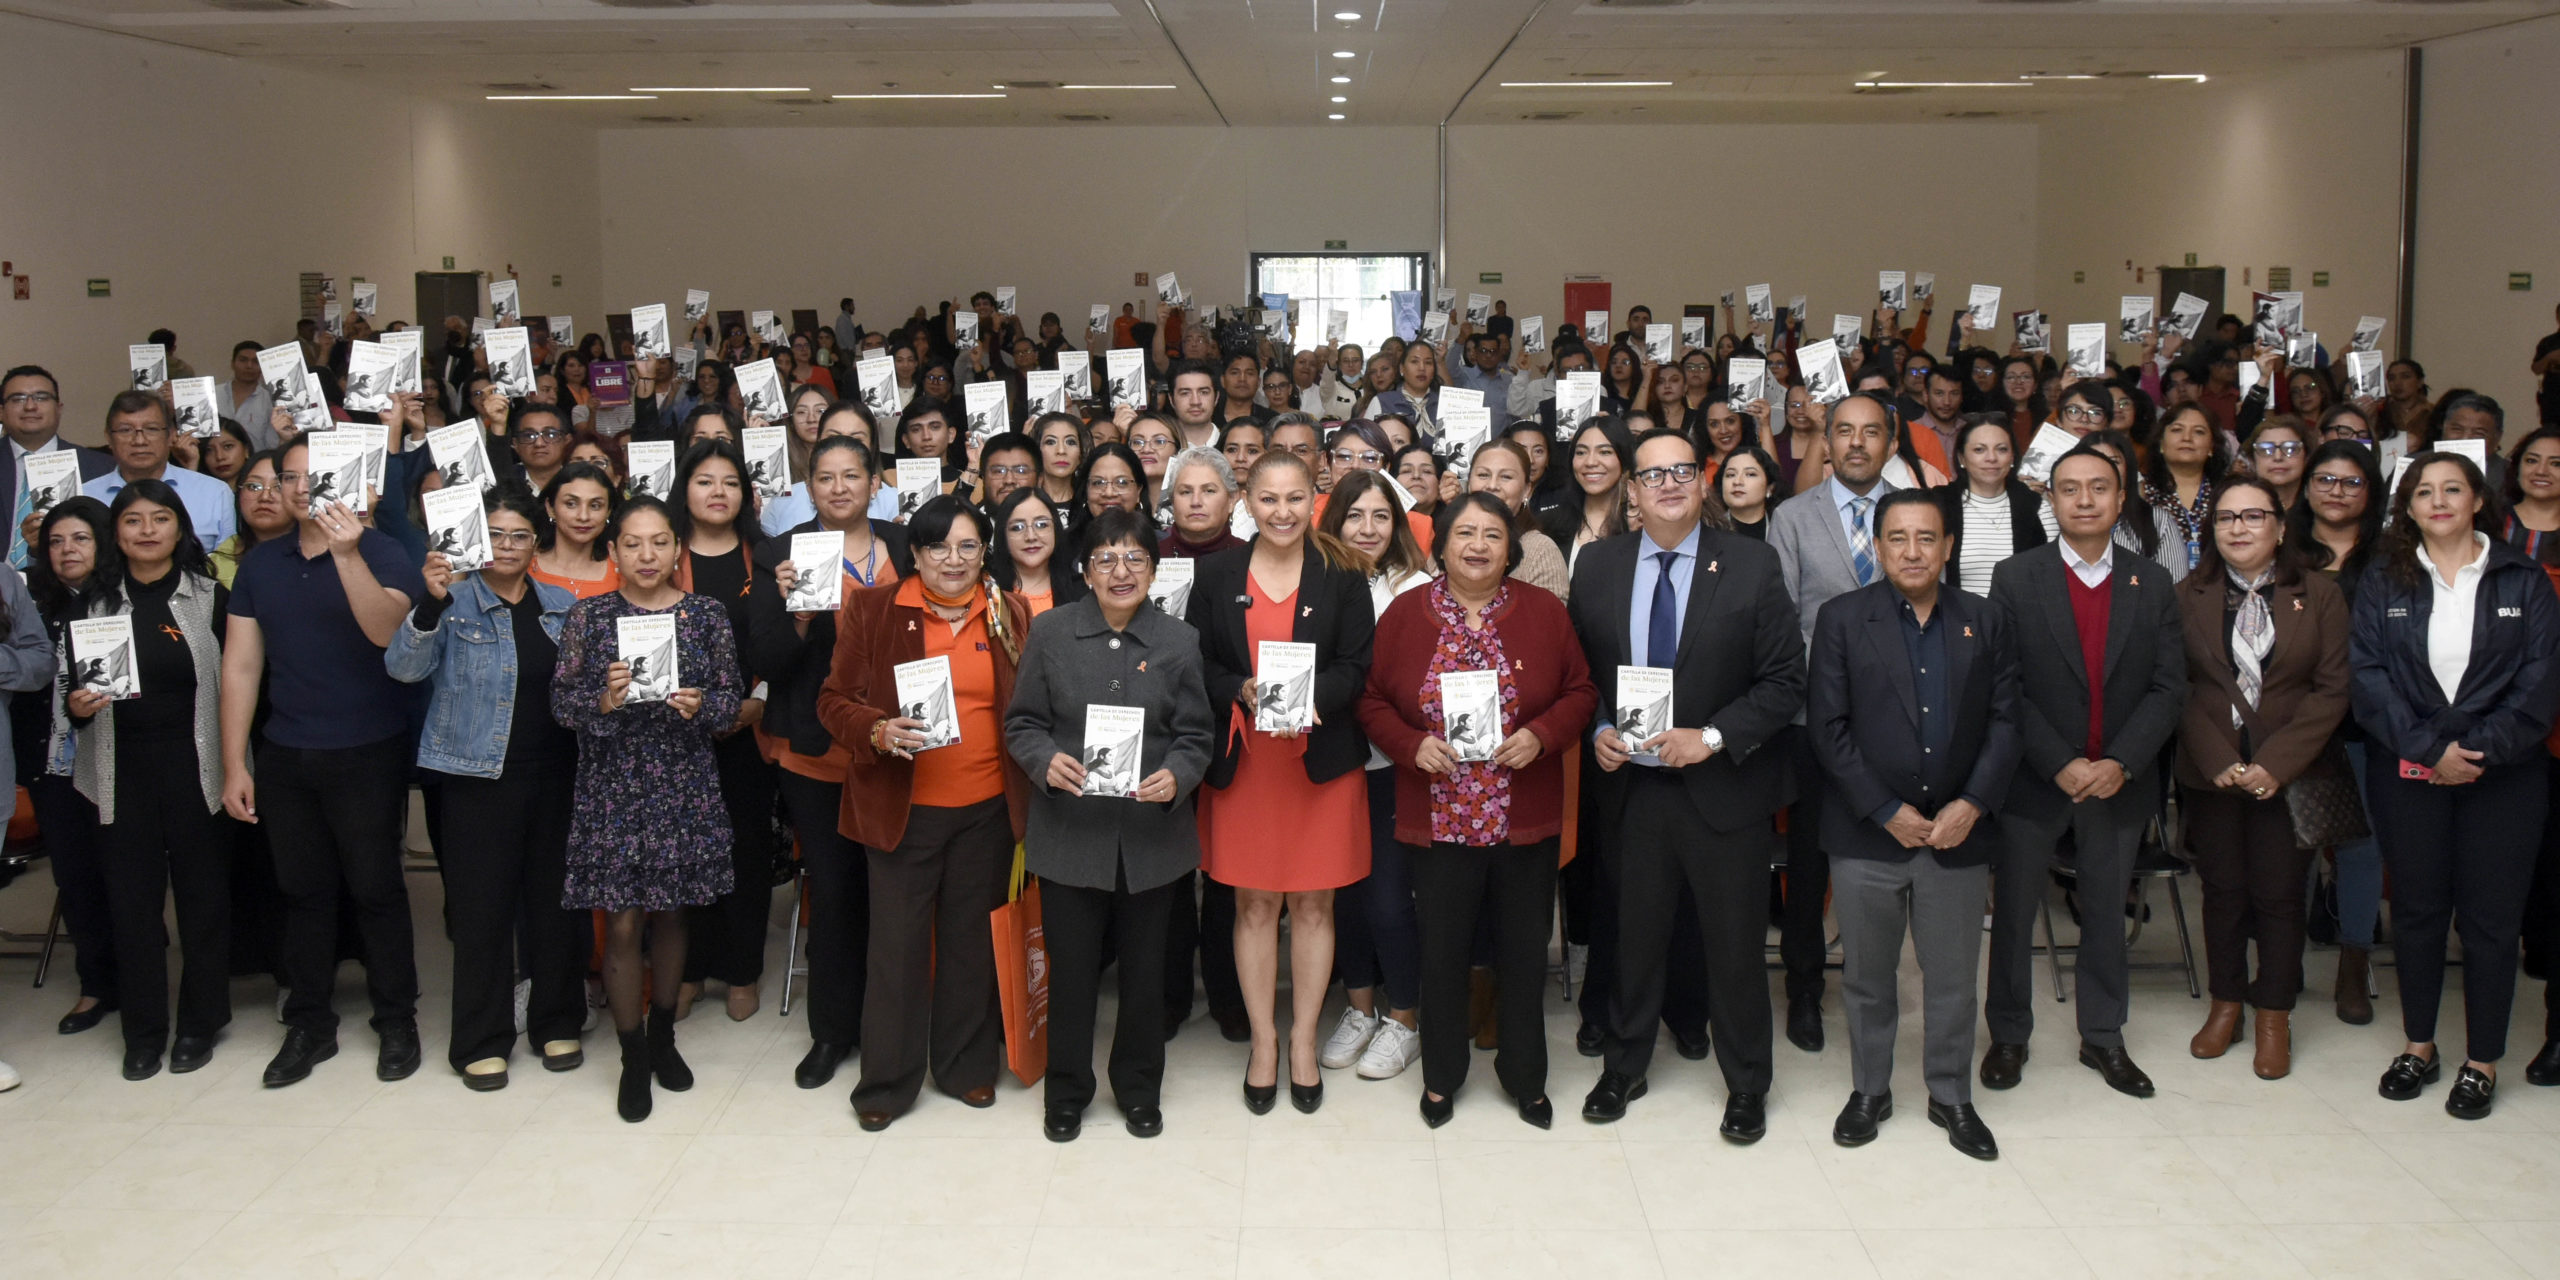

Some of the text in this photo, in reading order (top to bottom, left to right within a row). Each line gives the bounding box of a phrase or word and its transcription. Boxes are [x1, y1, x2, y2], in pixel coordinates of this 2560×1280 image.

[596, 378, 623, 386] LIBRE
[449, 427, 474, 438] Mujeres
[448, 492, 476, 502] Mujeres
[1284, 650, 1312, 659] Mujeres
[917, 665, 944, 675] Mujeres
[1642, 676, 1669, 684] Mujeres
[1112, 714, 1140, 723] Mujeres
